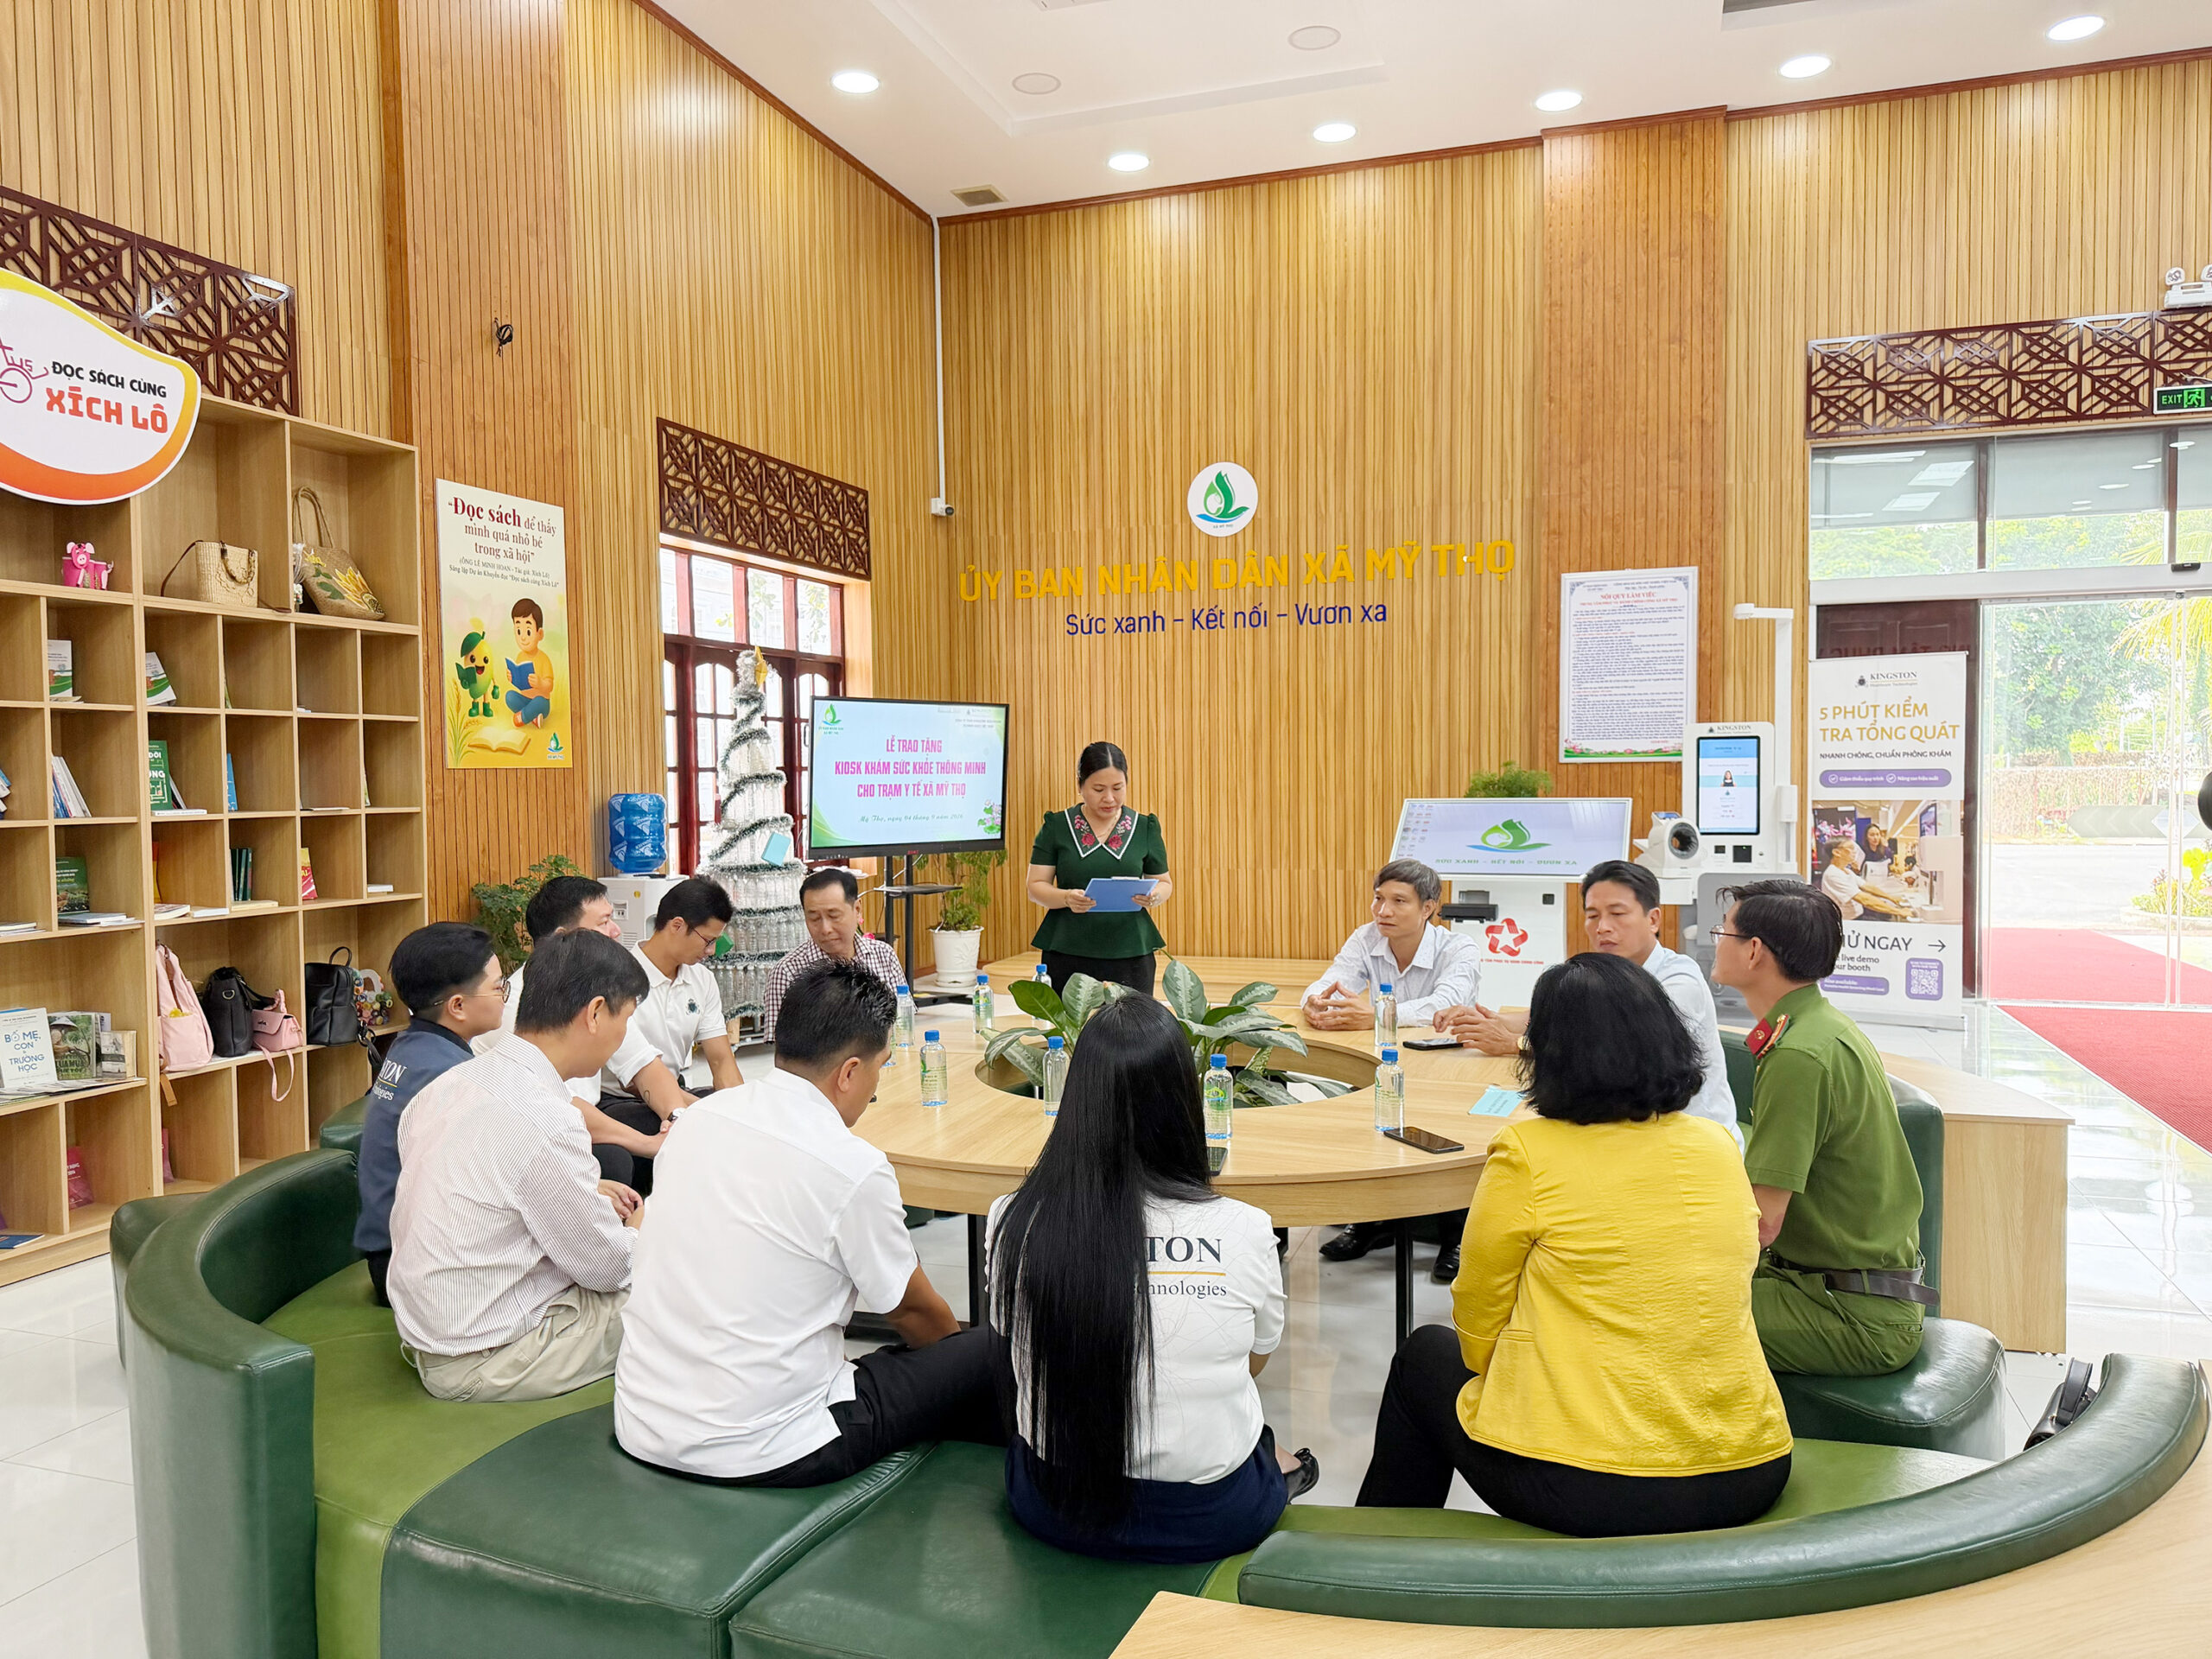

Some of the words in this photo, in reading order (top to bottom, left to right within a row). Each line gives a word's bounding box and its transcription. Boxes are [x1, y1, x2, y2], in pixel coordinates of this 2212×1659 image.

[52, 361, 84, 380] ĐỌC
[89, 369, 125, 389] SÁCH
[130, 378, 167, 397] CÙNG
[2162, 394, 2183, 404] EXIT
[46, 386, 123, 425] XÍCH
[131, 403, 168, 433] LÔ
[489, 505, 521, 527] sách
[524, 516, 535, 531] để
[537, 518, 556, 537] thấy
[465, 523, 490, 538] mình
[493, 529, 510, 543] quá
[512, 532, 530, 545] nhỏ
[532, 536, 543, 549] bé
[475, 543, 501, 559] trong
[503, 548, 514, 560] xã
[959, 565, 1002, 601] ỦY
[1014, 567, 1083, 599] BAN
[1098, 556, 1198, 595] NHÂN
[1212, 550, 1288, 589] DÂN
[1303, 544, 1355, 585] XÃ
[1366, 541, 1421, 582] MỸ
[1431, 539, 1515, 582] THỌ
[1066, 613, 1106, 635] Sức
[1115, 610, 1166, 633] xanh
[1192, 605, 1225, 631] Kết
[1234, 602, 1268, 629] nối
[1294, 603, 1351, 626] Vươn
[1360, 603, 1388, 623] xa
[1870, 671, 1917, 680] KINGSTON
[1820, 708, 1828, 721] 5
[1833, 701, 1880, 720] PHÚT
[1885, 696, 1929, 718] KIỂM
[1820, 728, 1853, 742] TRA
[1856, 720, 1906, 741] TỔNG
[1910, 721, 1960, 743] QUÁT
[887, 735, 895, 753] LỄ
[898, 740, 918, 753] TRAO
[921, 738, 943, 756] TẶNG
[1847, 751, 1874, 760] CHÓNG,
[1875, 749, 1901, 759] CHUẨN
[1903, 750, 1929, 759] PHÒNG
[835, 761, 861, 775] KIOSK
[864, 759, 891, 775] KHÁM
[893, 759, 910, 775] SỨC
[912, 757, 933, 775] KHỎE
[936, 760, 963, 775] THÔNG
[964, 761, 986, 775] MINH
[857, 784, 874, 798] CHO
[878, 784, 902, 800] TRẠM
[905, 784, 910, 798] Y
[912, 780, 922, 797] TẾ
[923, 781, 934, 797] XÃ
[936, 781, 950, 796] MỸ
[951, 783, 966, 799] THỌ
[1865, 936, 1912, 950] NGAY
[1842, 954, 1855, 963] live
[1847, 963, 1871, 972] booth
[4, 1030, 20, 1043] BỐ
[14, 1042, 34, 1051] CON
[9, 1054, 45, 1065] TRƯỜNG
[18, 1063, 38, 1073] HỌC
